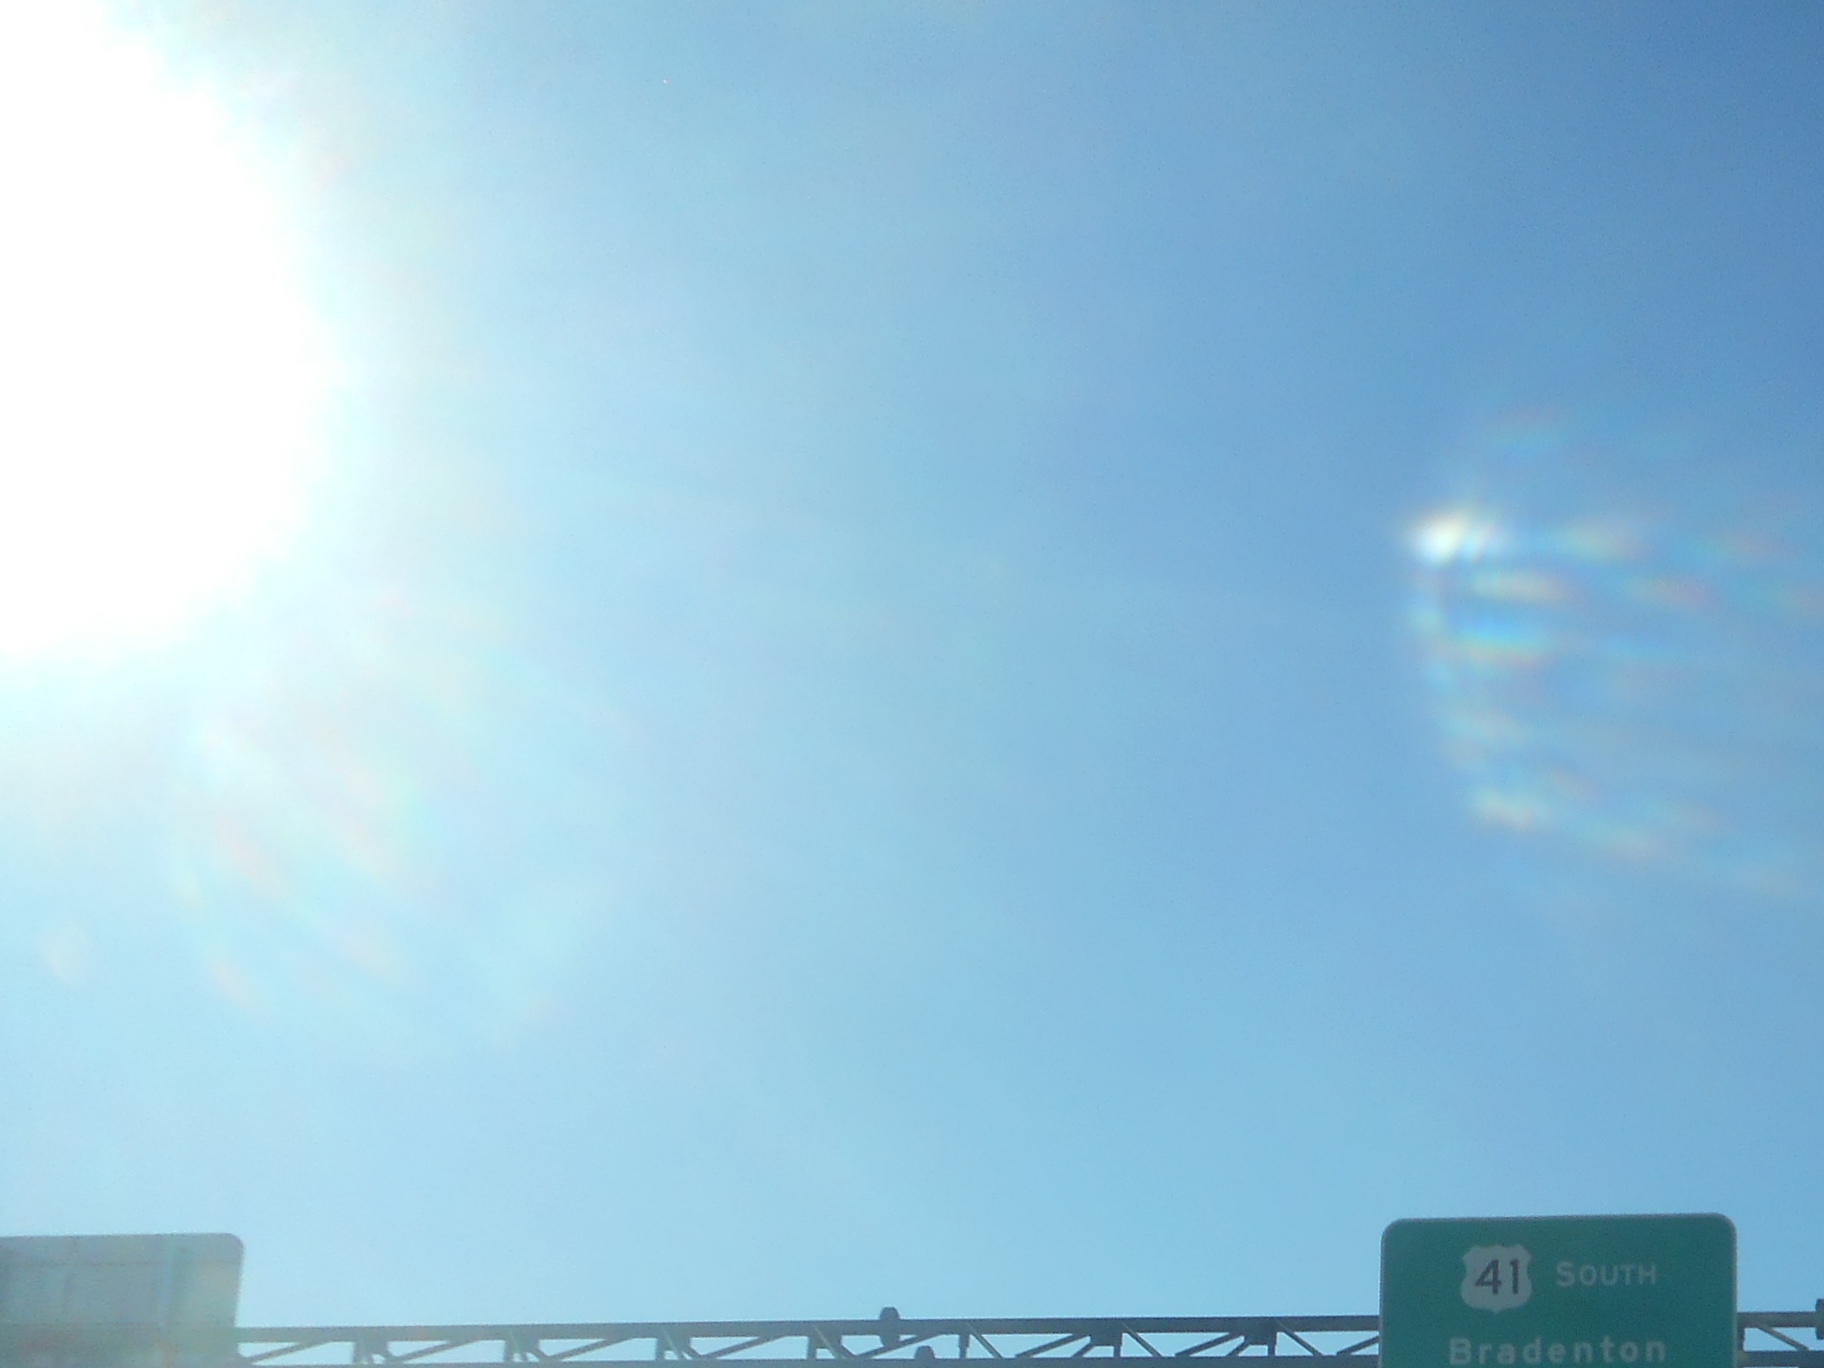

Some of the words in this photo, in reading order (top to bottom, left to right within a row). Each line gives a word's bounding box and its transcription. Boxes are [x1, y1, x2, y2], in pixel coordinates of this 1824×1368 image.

[1474, 1258, 1519, 1295] 41
[1555, 1260, 1658, 1288] SOUTH
[1449, 1334, 1667, 1366] Bradenton
